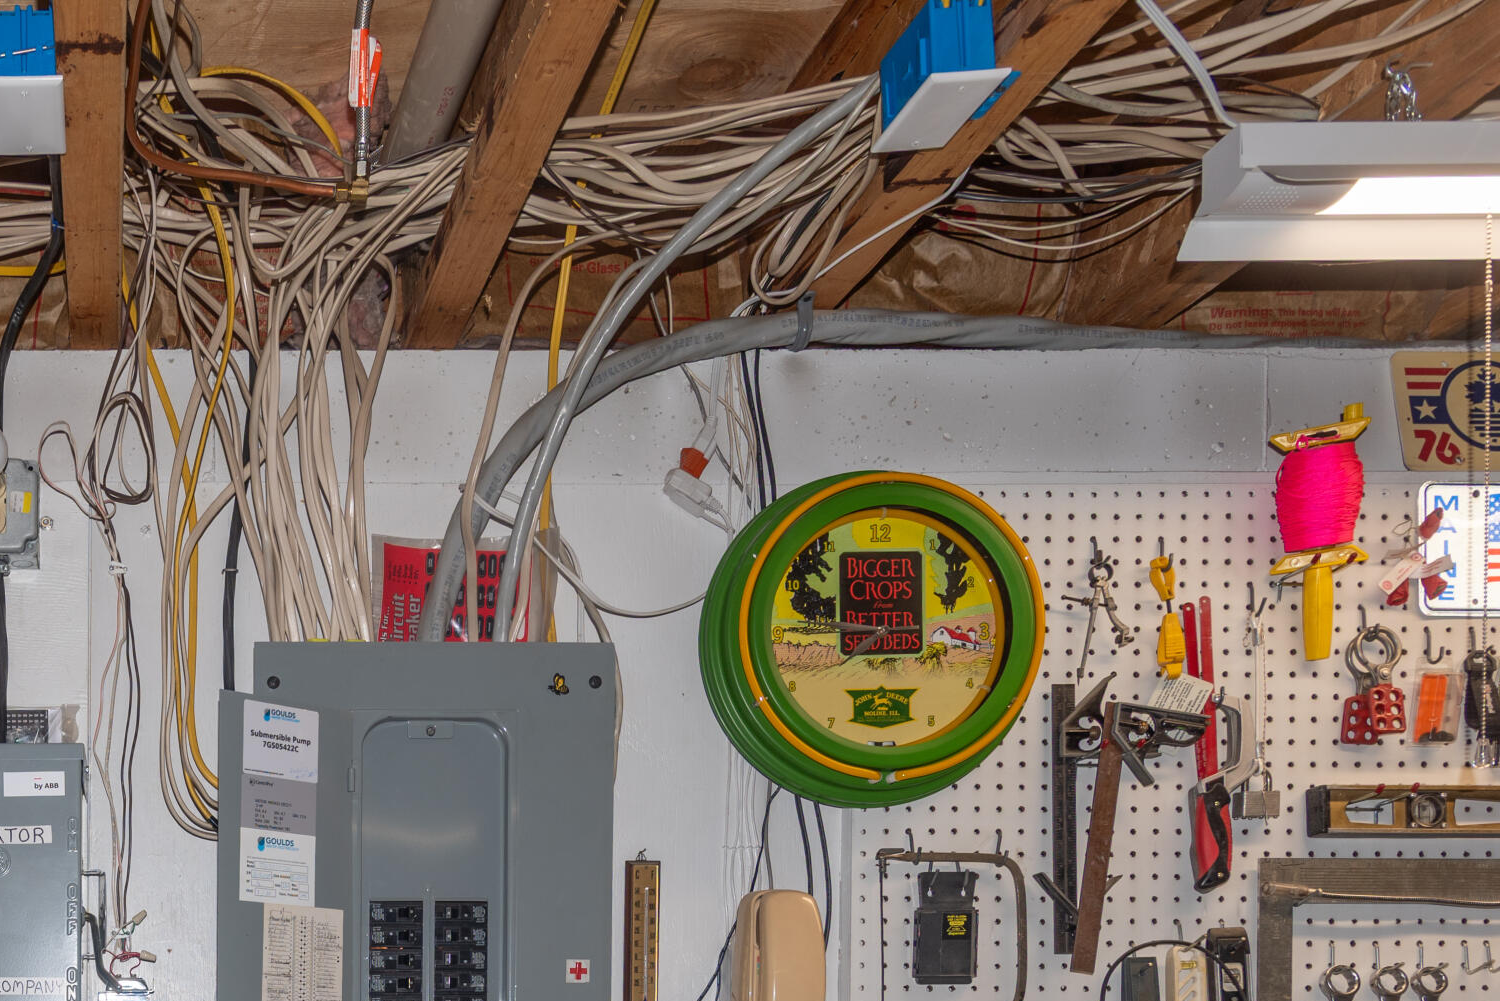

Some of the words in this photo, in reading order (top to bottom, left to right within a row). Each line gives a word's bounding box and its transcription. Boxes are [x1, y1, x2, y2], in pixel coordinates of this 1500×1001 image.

[586, 262, 621, 274] Glass
[1210, 307, 1272, 319] Warning:
[1413, 429, 1461, 465] 76
[869, 524, 892, 543] 12
[822, 541, 836, 553] 11
[929, 539, 936, 550] 1
[846, 557, 916, 578] BIGGER
[787, 579, 800, 592] 10
[966, 576, 975, 588] 2
[850, 580, 913, 600] CROPS
[389, 593, 405, 642] ircuit
[406, 594, 420, 642] eaker
[846, 611, 914, 628] BETTER
[773, 626, 784, 643] 9
[979, 622, 990, 640] 3
[883, 633, 920, 650] BEDS
[788, 680, 796, 693] 8
[966, 678, 974, 689] 4
[855, 693, 872, 706] JOHN
[886, 692, 909, 704] DEERE
[271, 709, 296, 719] GOULDS
[927, 715, 935, 727] 5
[827, 717, 835, 728] 7
[250, 729, 291, 743] Submersible
[293, 736, 311, 746] Pump
[34, 782, 43, 790] by
[265, 837, 295, 847] GOULDS
[66, 883, 78, 936] OFF
[66, 967, 78, 1001] ON
